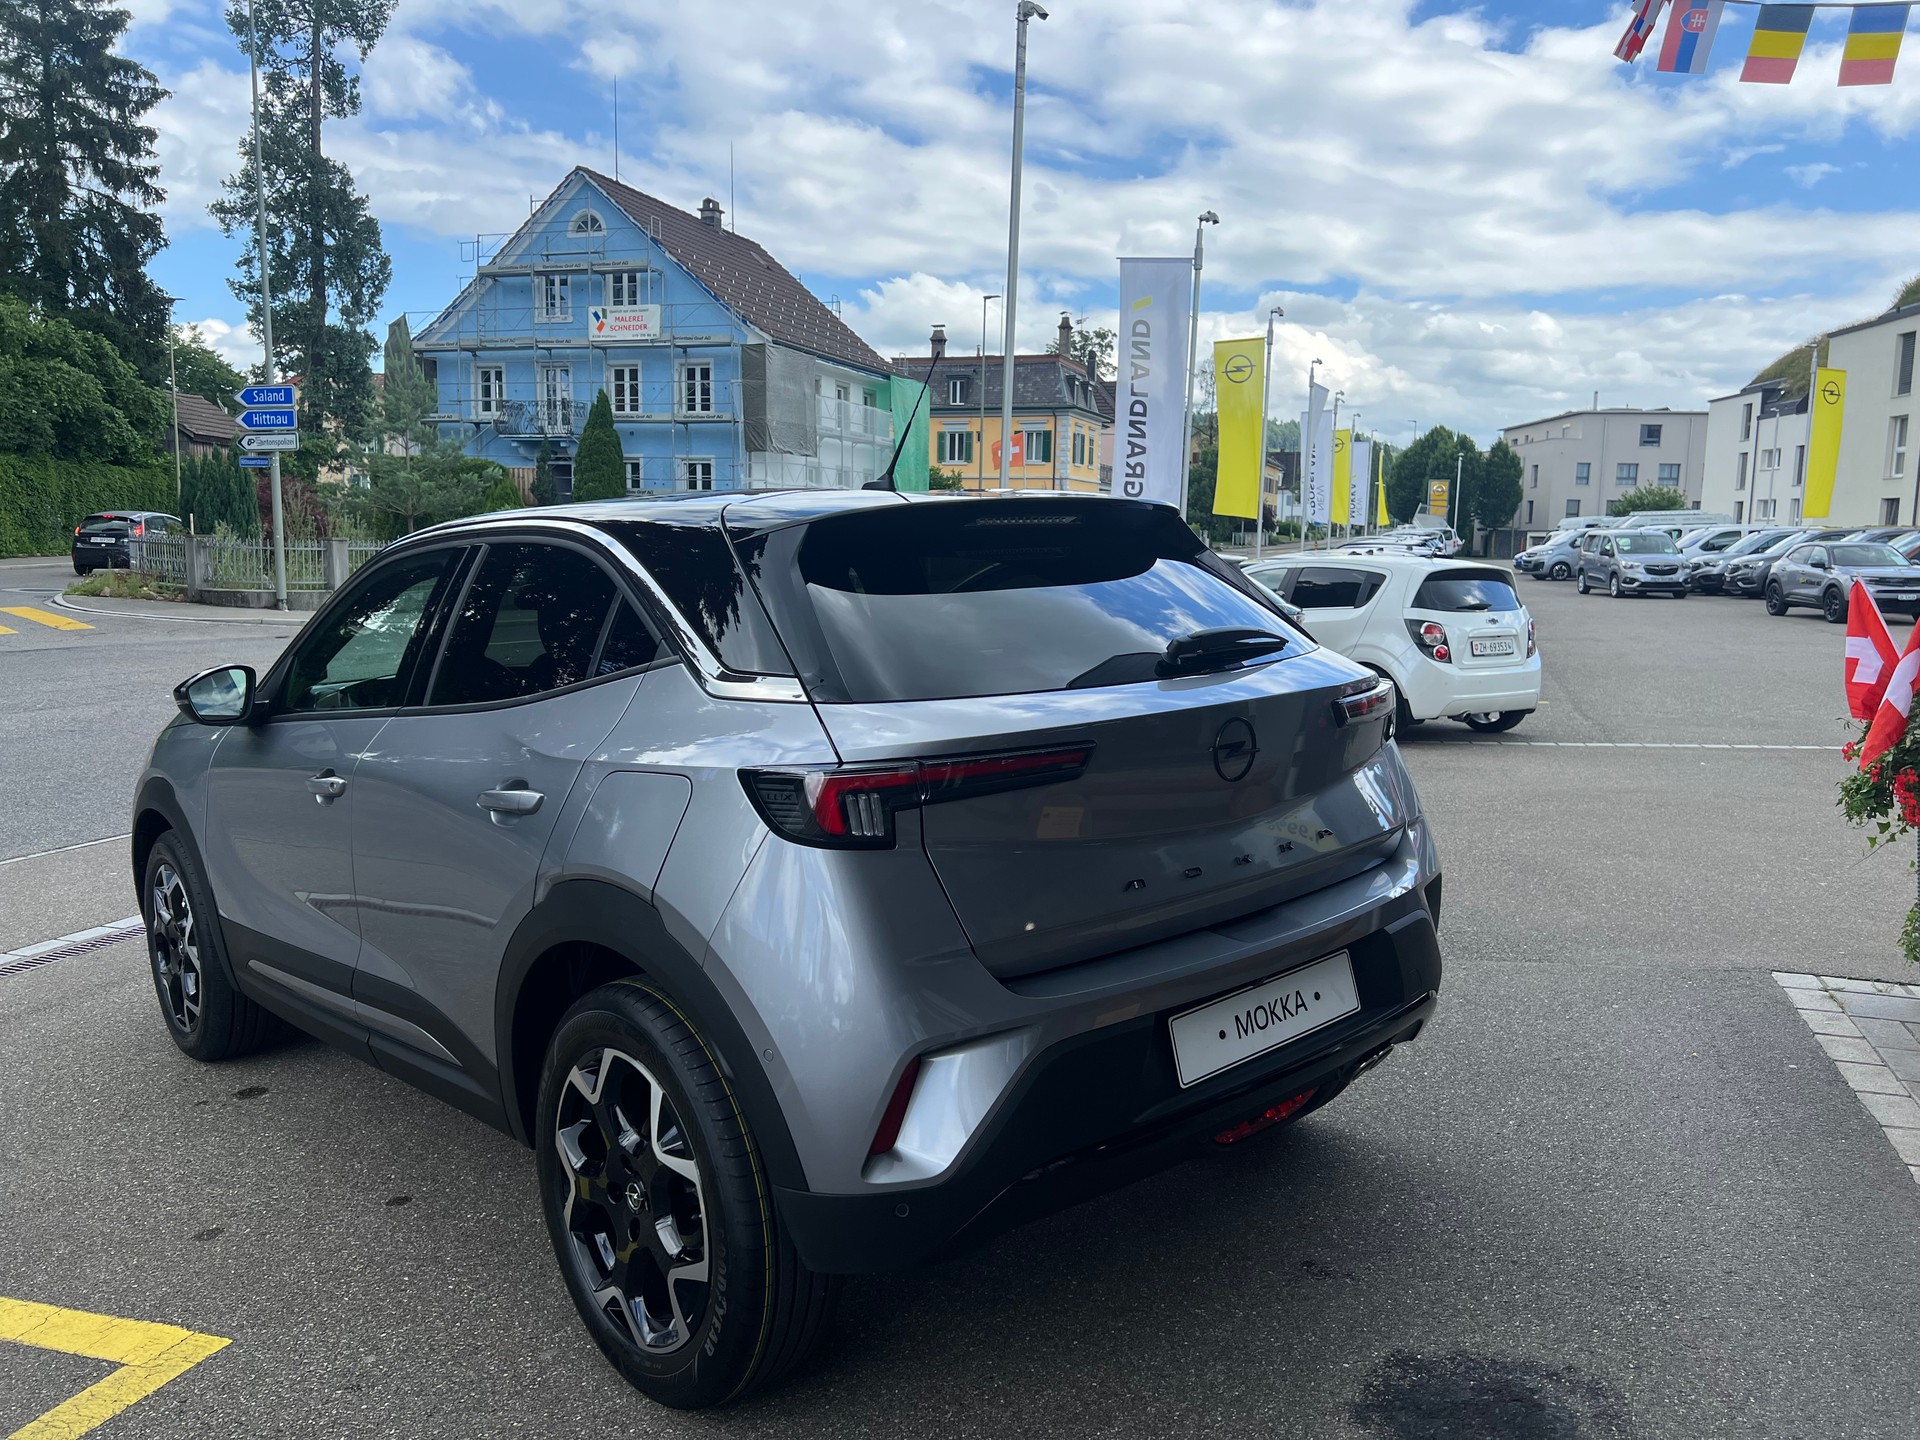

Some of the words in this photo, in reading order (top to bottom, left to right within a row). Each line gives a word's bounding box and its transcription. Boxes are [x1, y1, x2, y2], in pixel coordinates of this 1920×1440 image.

[609, 323, 648, 331] SCHNEIDER
[253, 389, 285, 402] Saland
[253, 413, 288, 425] Hittnau
[1234, 990, 1309, 1039] MOKKA
